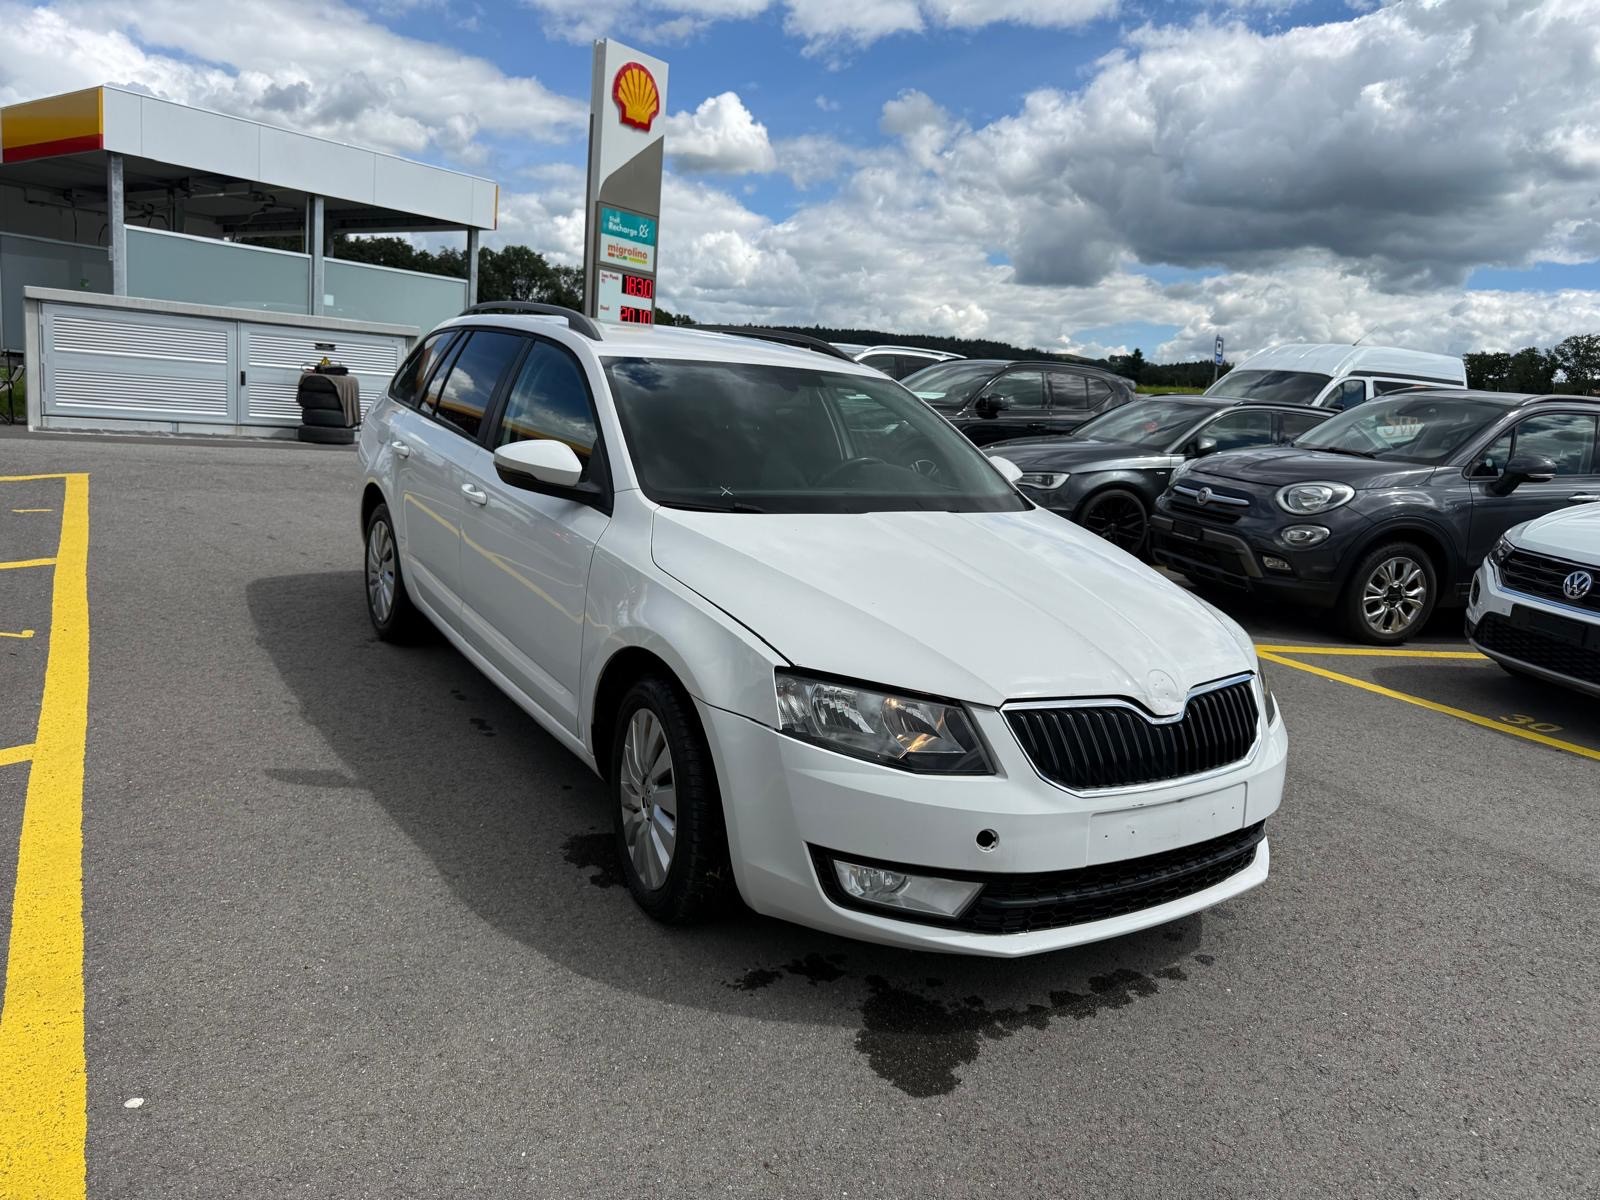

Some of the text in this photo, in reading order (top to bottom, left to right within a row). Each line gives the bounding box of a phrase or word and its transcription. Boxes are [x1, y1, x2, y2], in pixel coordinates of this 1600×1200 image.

[608, 222, 638, 237] Recharge
[607, 244, 648, 260] migrolino
[1563, 570, 1592, 600] VW
[1499, 713, 1565, 733] 30
